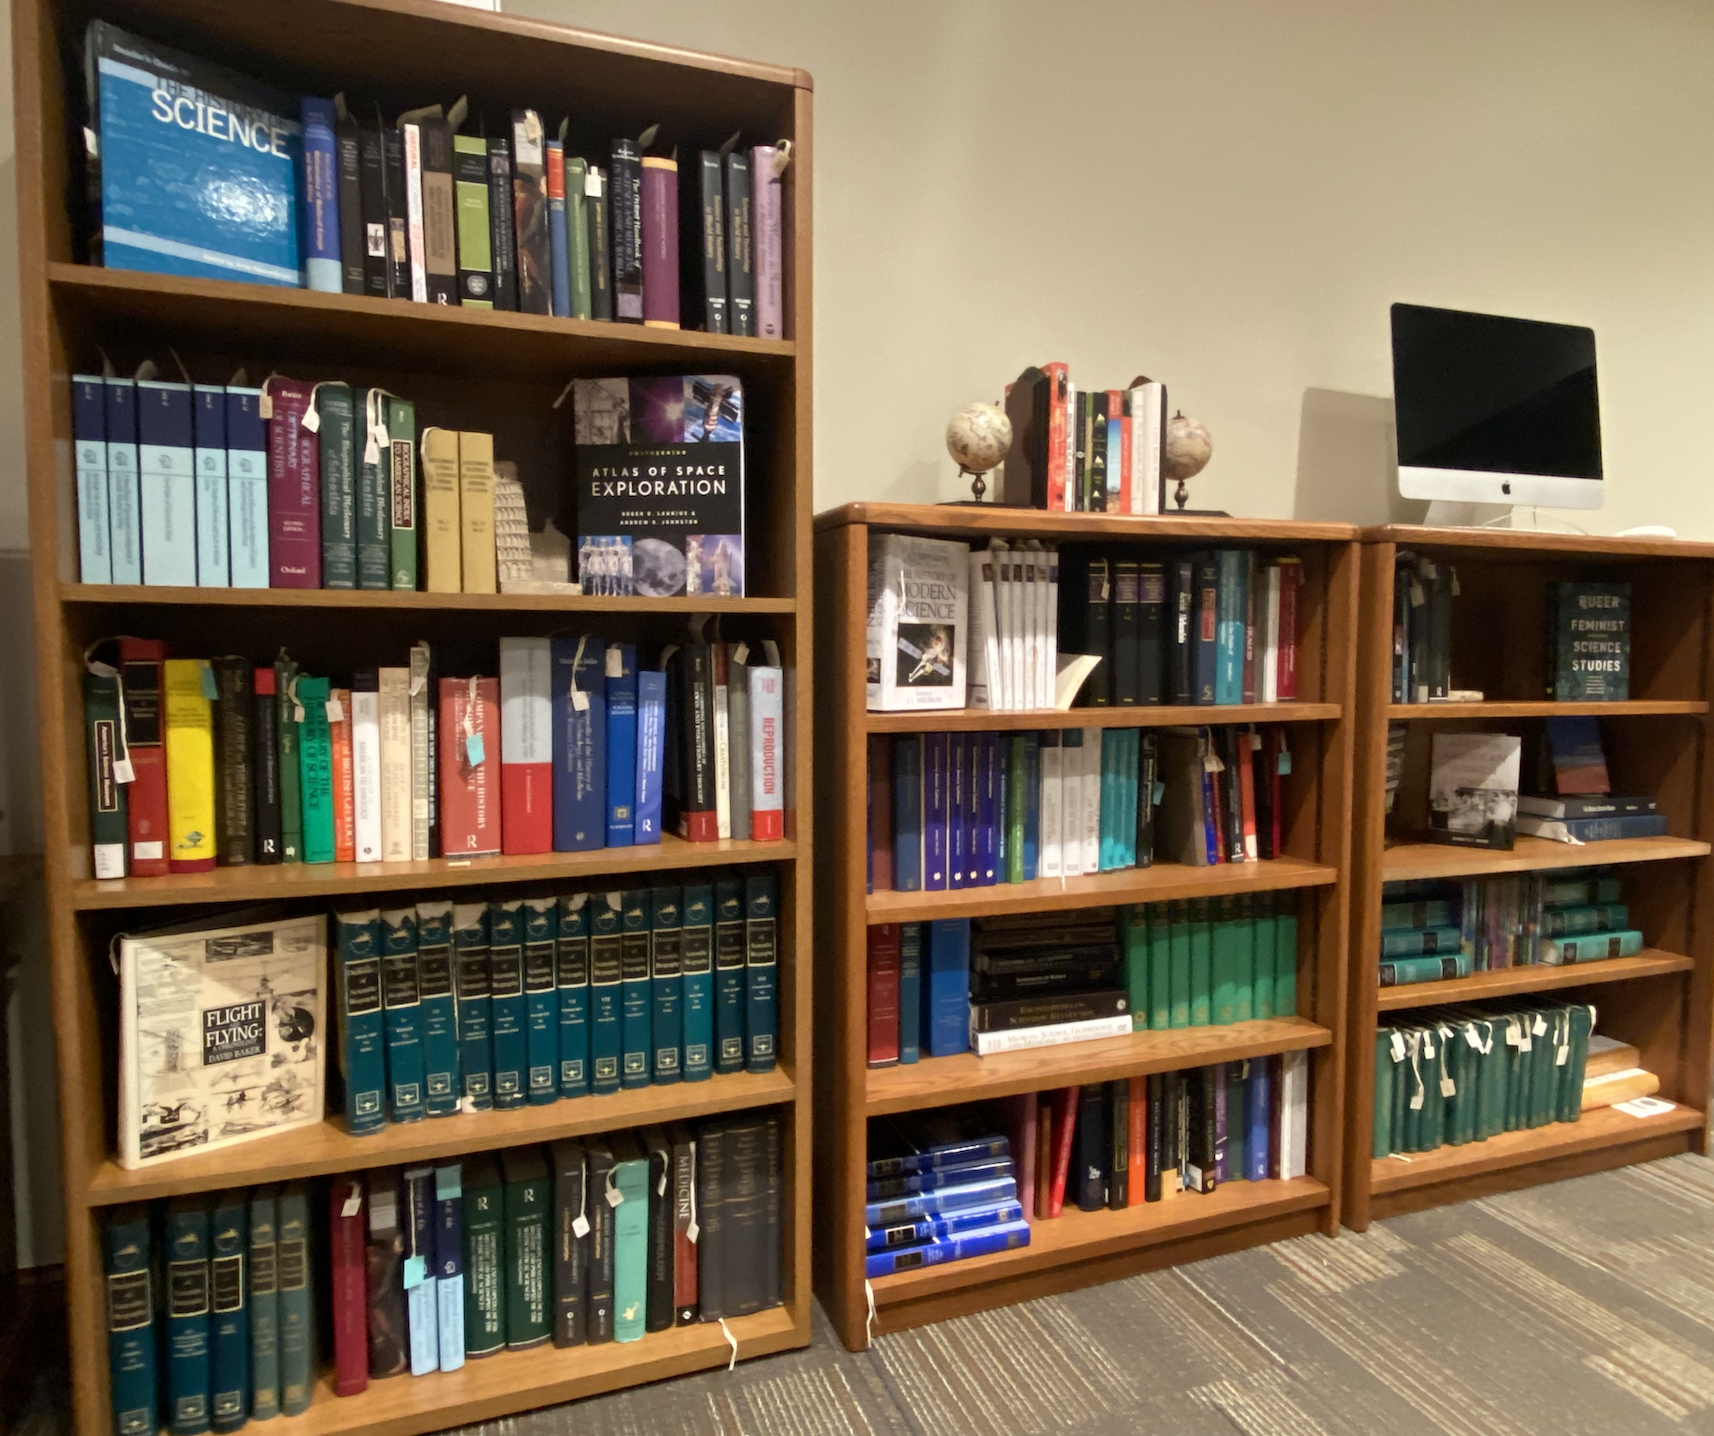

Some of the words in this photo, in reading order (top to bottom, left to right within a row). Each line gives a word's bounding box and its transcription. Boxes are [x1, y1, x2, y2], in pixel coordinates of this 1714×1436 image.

[151, 89, 291, 160] SCIENCE
[614, 176, 622, 195] THE
[623, 169, 632, 208] SCIENCE
[632, 178, 640, 193] The
[615, 196, 624, 246] CLASSICAL
[624, 210, 633, 230] AND
[632, 194, 640, 220] Oxford
[624, 230, 634, 273] MEDICINE
[633, 220, 642, 258] Handbook
[616, 246, 625, 279] WORLD
[632, 259, 642, 270] of
[287, 410, 298, 470] DICTIONARY
[340, 422, 350, 437] The
[394, 443, 402, 455] TO
[340, 438, 351, 494] Biographical
[394, 455, 402, 494] AMERICAN
[402, 442, 410, 497] BIOGRAPHICAL
[592, 466, 639, 478] ATLAS
[648, 466, 668, 476] OF
[676, 465, 726, 476] SPACE
[328, 459, 340, 516] Scientists
[590, 480, 726, 496] EXPLORATION
[342, 494, 352, 540] Dictionary
[374, 497, 386, 540] Dictionary
[395, 495, 403, 526] SCIENCE
[402, 498, 410, 521] INDEX
[280, 566, 306, 574] Oxford
[897, 582, 956, 600] MODERN
[1578, 595, 1620, 609] QUEER
[898, 602, 954, 619] SCIENCE
[1570, 619, 1625, 631] FEMINIST
[1573, 641, 1621, 654] SCIENCE
[1572, 659, 1621, 672] STUDIES
[304, 696, 316, 742] HISTORY
[316, 696, 329, 758] DICTIONARY
[306, 746, 317, 759] OF
[358, 740, 367, 775] AMERICAN
[694, 724, 702, 772] EVOLUTIONARY
[762, 717, 776, 795] REPRODUCTION
[319, 759, 328, 774] OF
[342, 757, 352, 796] BRITISH
[477, 766, 486, 787] THE
[719, 742, 728, 790] CREATIONISM
[308, 762, 320, 812] SCIENCE
[320, 778, 330, 797] THE
[360, 776, 368, 821] TECHNOLOGY
[696, 773, 704, 804] THOUGHT
[343, 796, 354, 848] GEOLOGY
[477, 787, 486, 830] HISTORY
[206, 1003, 262, 1028] FLIGHT
[206, 1023, 262, 1048] FLYING:
[208, 1052, 233, 1063] DAVID
[234, 1046, 260, 1058] BAKER
[678, 1155, 690, 1220] MEDICINE
